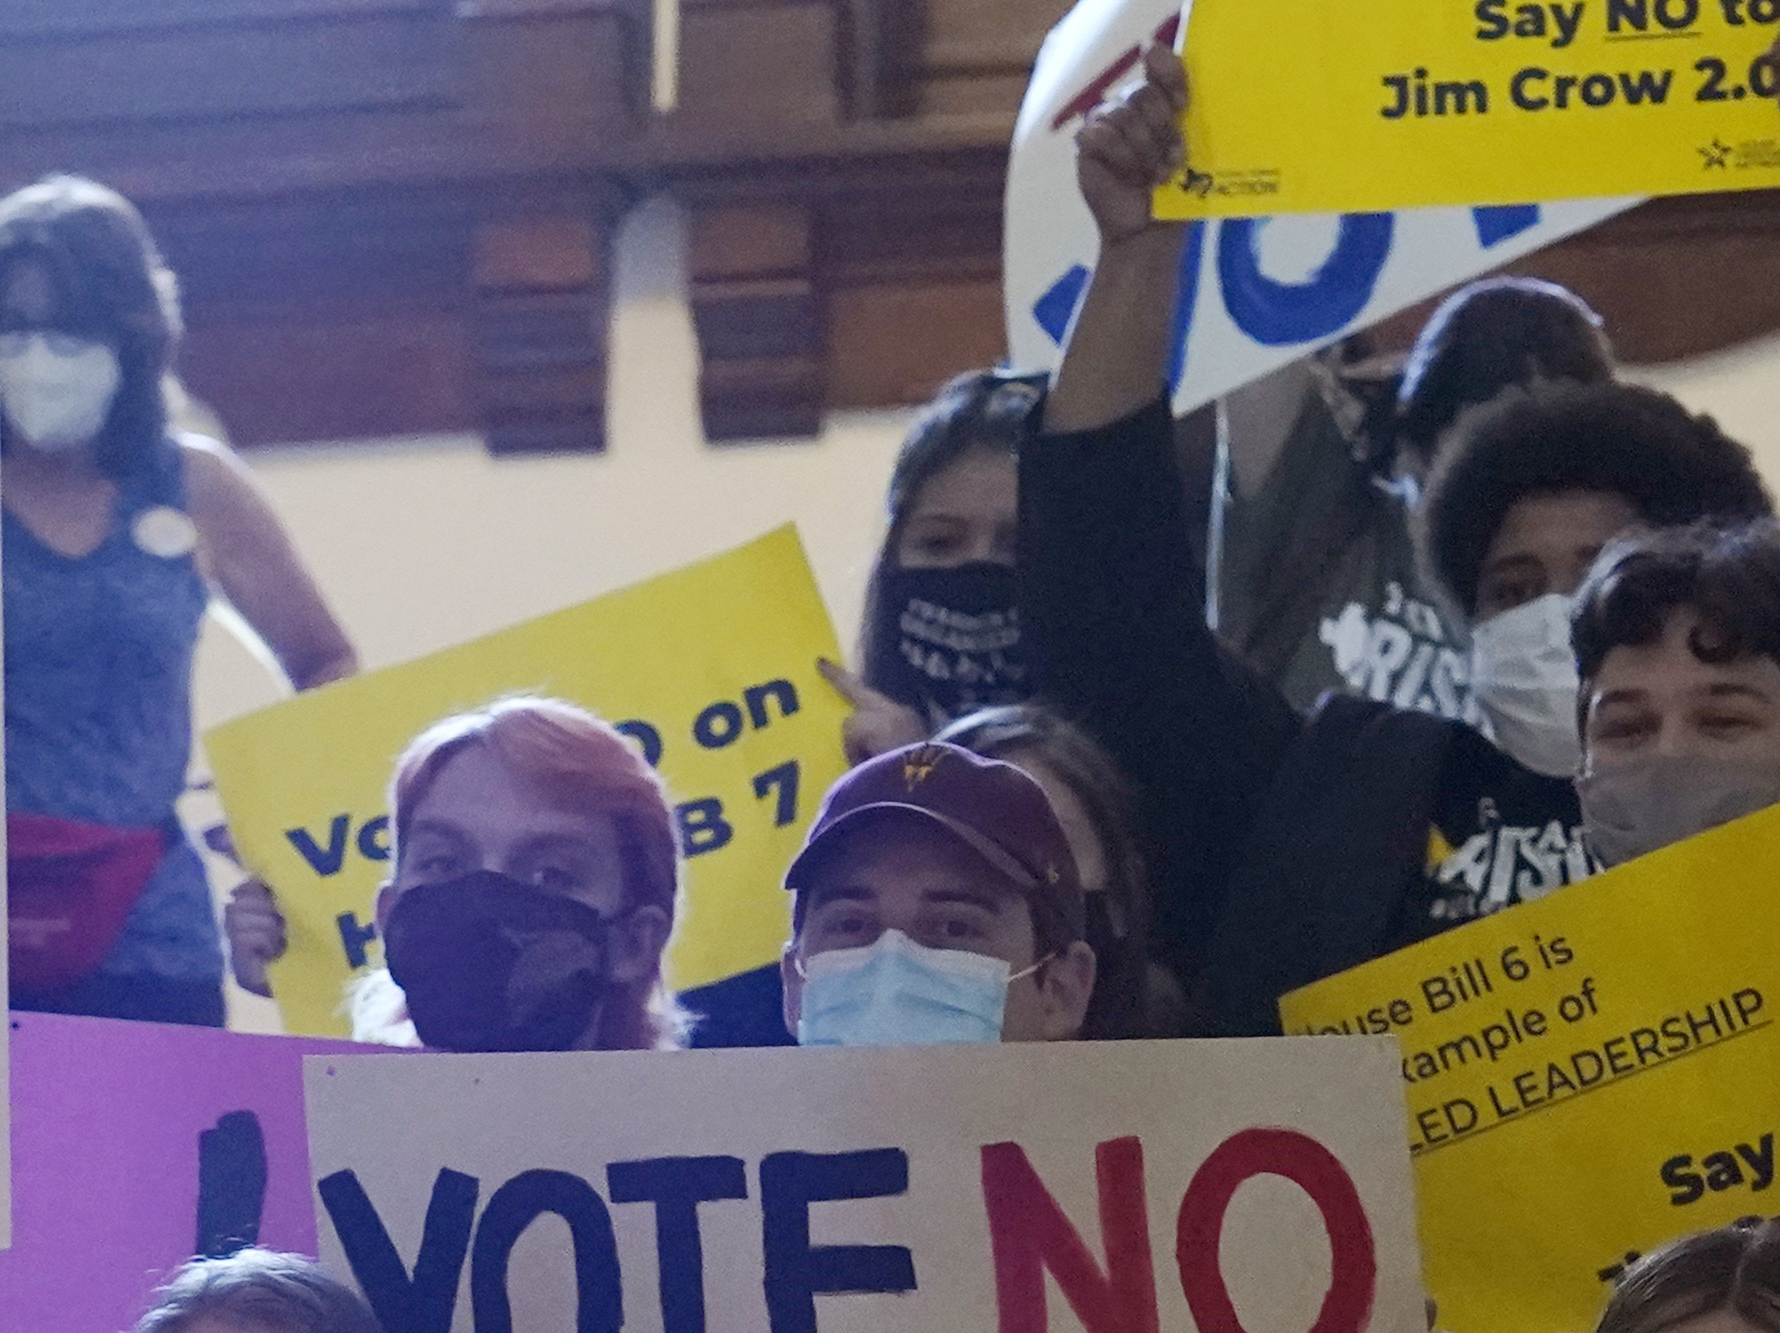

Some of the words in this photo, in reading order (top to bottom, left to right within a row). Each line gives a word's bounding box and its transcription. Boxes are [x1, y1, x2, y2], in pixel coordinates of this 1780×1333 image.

[1475, 0, 1585, 48] Say
[1606, 0, 1700, 32] NO
[1380, 67, 1489, 119] Jim
[1510, 66, 1674, 112] Crow
[692, 677, 800, 749] on
[753, 760, 801, 828] 7
[1422, 958, 1494, 1014] Bill
[1500, 944, 1528, 983] 6
[1535, 930, 1575, 971] is
[1556, 980, 1600, 1025] of
[1488, 987, 1766, 1119] LEADERSHIP
[1660, 1132, 1775, 1207] Say
